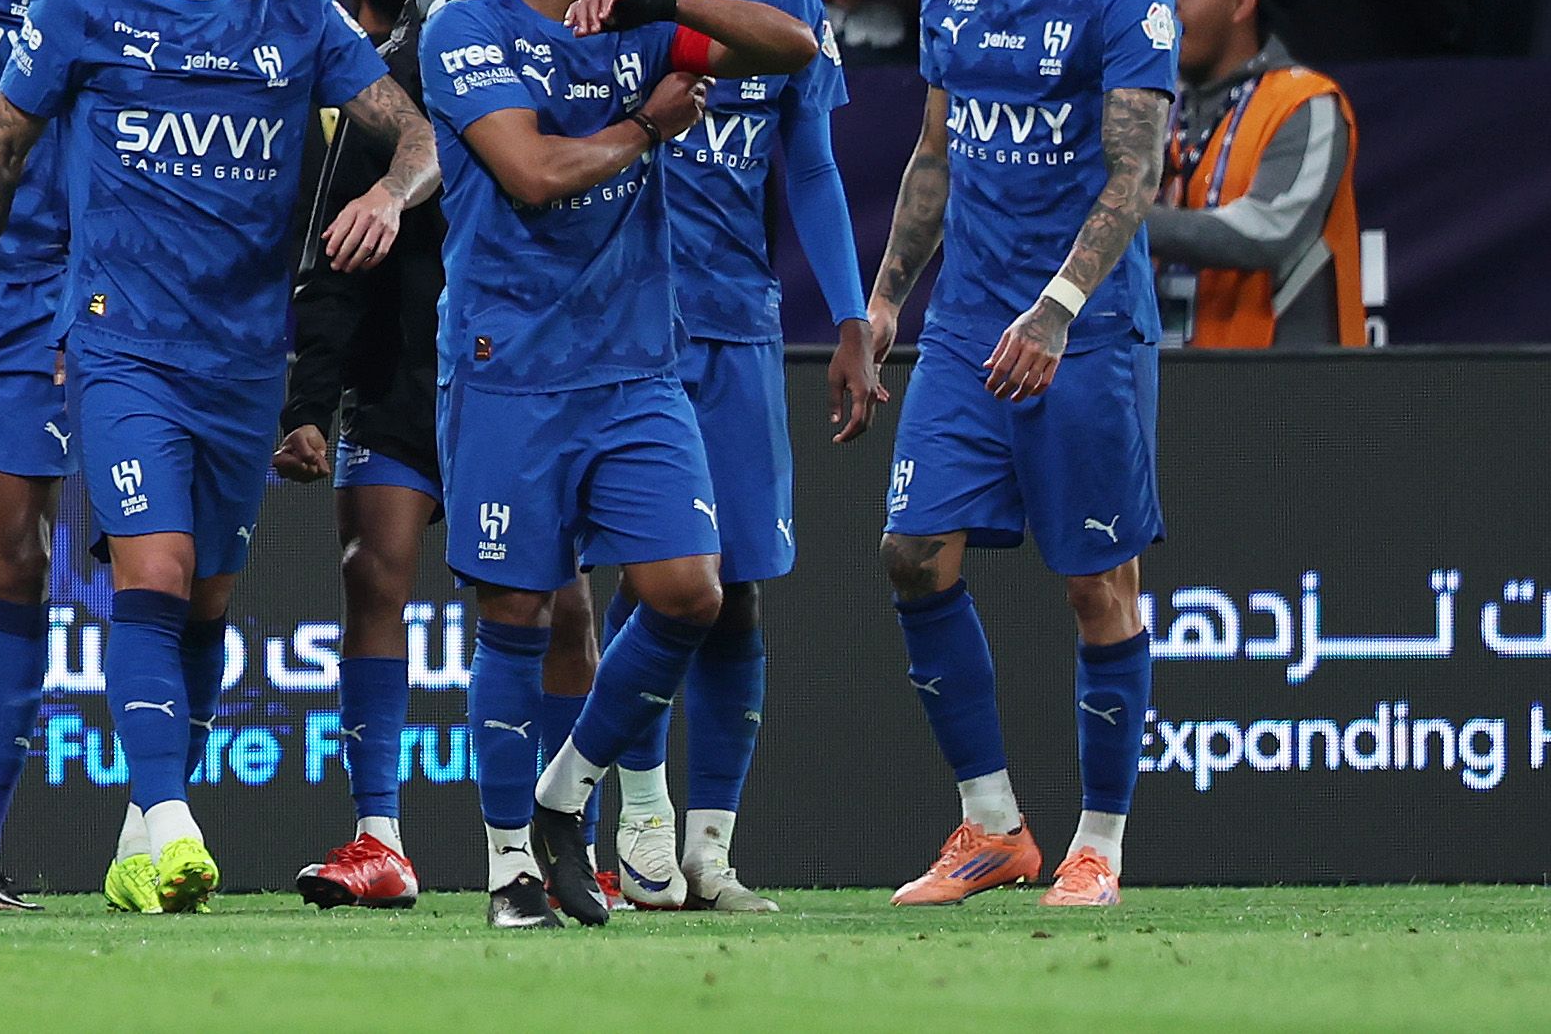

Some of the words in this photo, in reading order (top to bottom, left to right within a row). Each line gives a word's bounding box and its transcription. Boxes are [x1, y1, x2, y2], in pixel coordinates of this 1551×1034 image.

[440, 45, 504, 74] tree
[564, 82, 611, 100] Jahe
[116, 110, 285, 160] SAVVY
[121, 154, 202, 177] GAMES
[214, 165, 279, 181] GROUP
[996, 150, 1075, 165] GROUP
